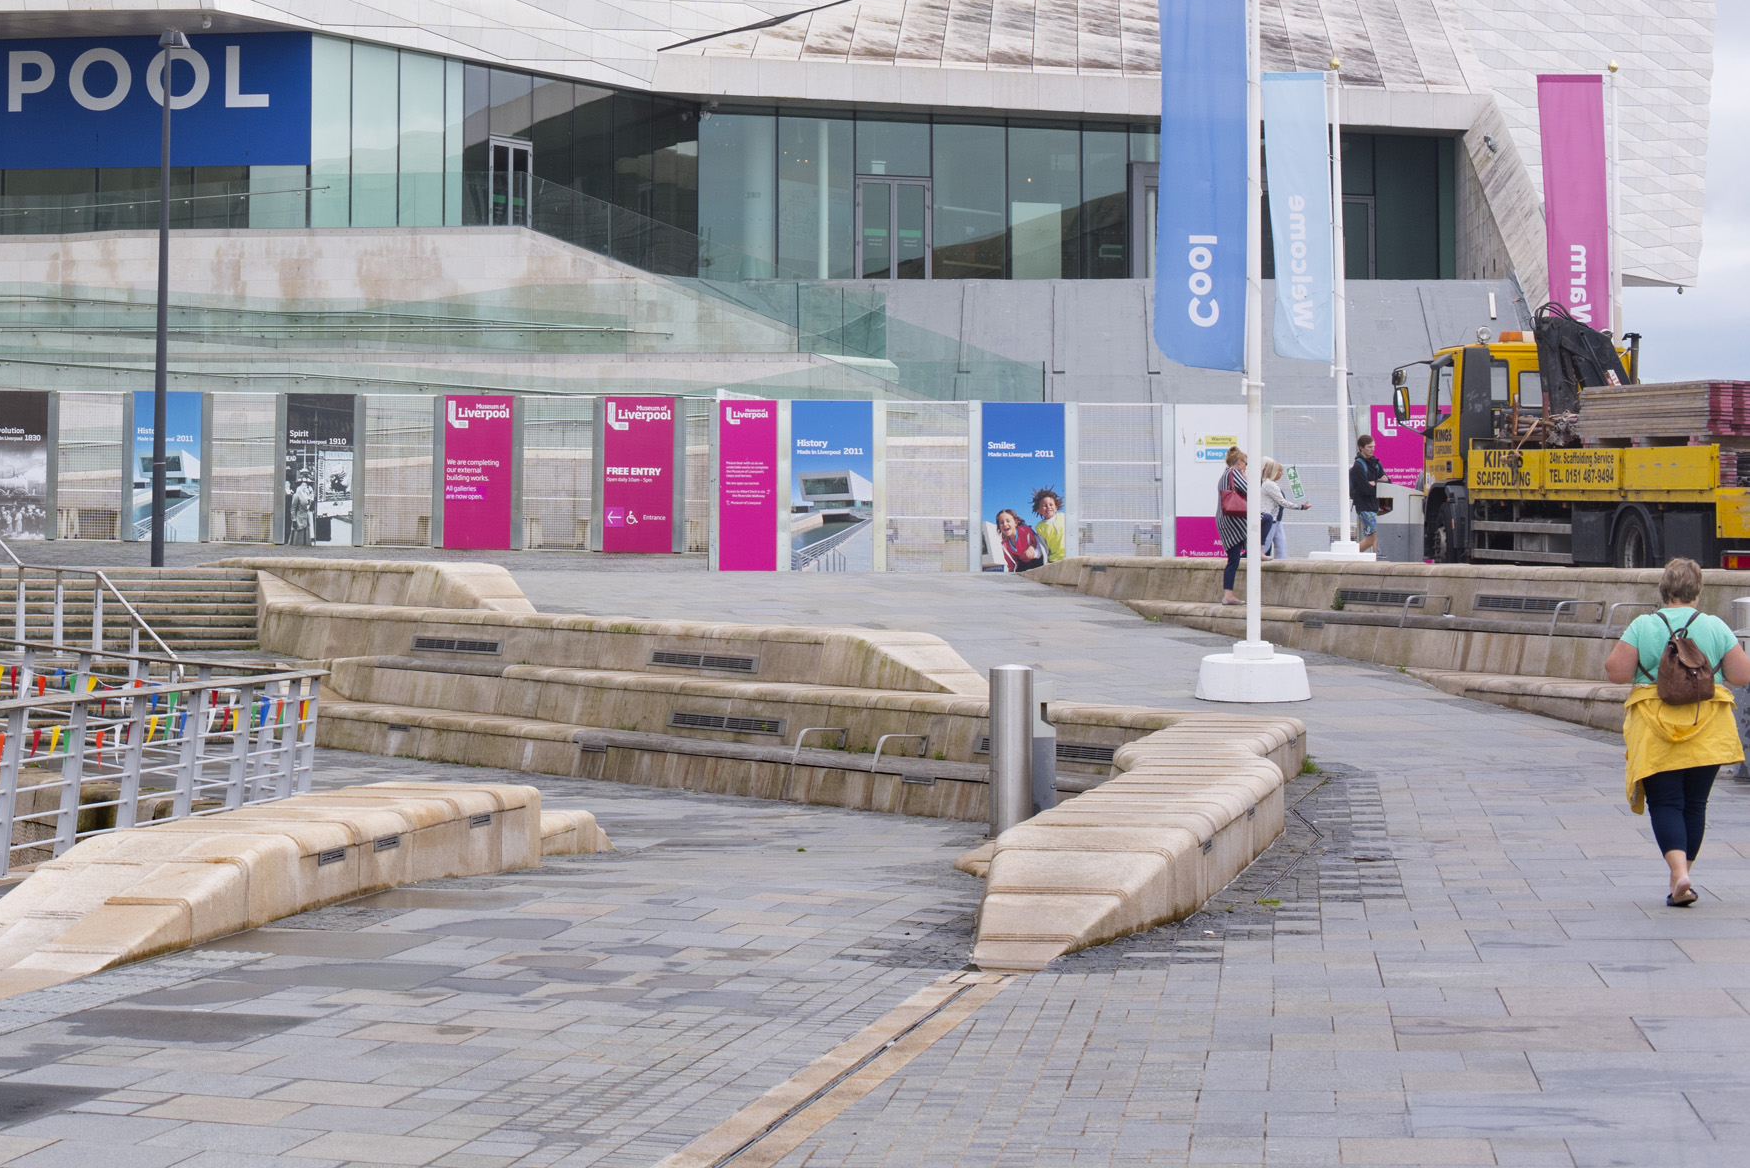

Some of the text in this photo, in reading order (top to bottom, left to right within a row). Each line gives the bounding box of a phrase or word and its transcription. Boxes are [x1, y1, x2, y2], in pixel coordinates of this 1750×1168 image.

[1288, 195, 1315, 331] Welcome
[1189, 235, 1219, 327] Cool
[1570, 244, 1592, 324] Warm
[458, 408, 509, 420] Liverpool
[618, 409, 671, 422] Liverpool
[733, 411, 768, 419] Liverpool
[290, 430, 309, 438] Spirit
[1435, 429, 1452, 442] KINGS
[797, 439, 828, 448] History
[1549, 452, 1614, 467] 24hr. Scaffolding Service
[606, 467, 661, 476] FREE ENTRY
[1549, 469, 1614, 483] TEL. 0151 487-9494
[1477, 471, 1531, 486] SCAFFOLDNG
